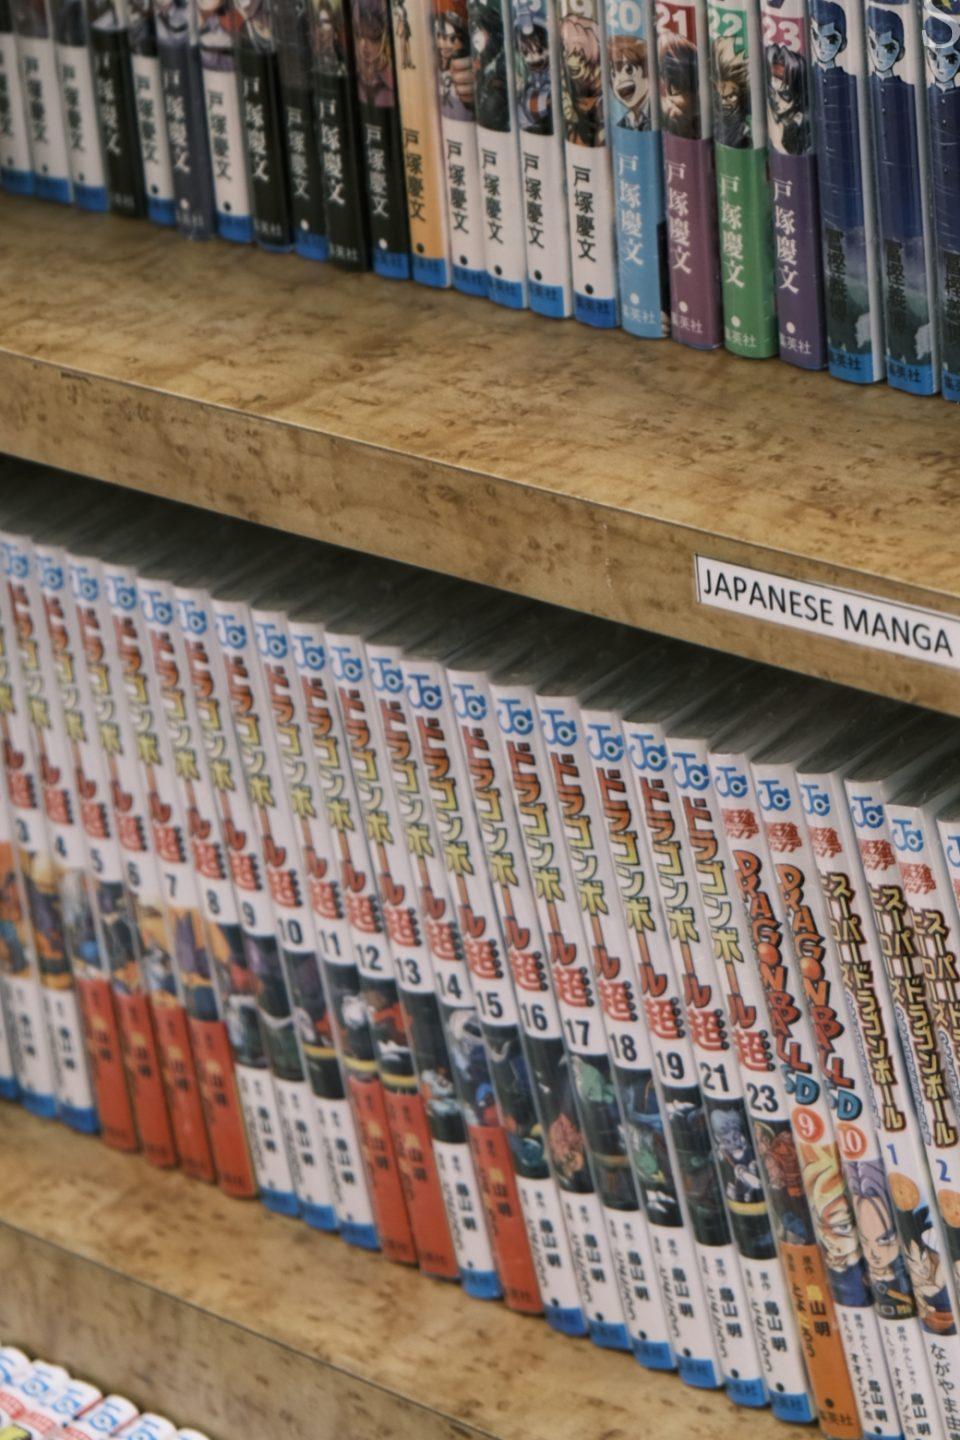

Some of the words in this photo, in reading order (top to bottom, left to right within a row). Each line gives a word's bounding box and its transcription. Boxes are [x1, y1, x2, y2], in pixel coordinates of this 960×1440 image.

[656, 6, 688, 37] 21
[763, 19, 800, 53] 23
[703, 568, 834, 626] JAPANESE
[843, 604, 954, 657] MANGA
[242, 900, 257, 927] 9
[277, 915, 303, 945] 10
[475, 990, 504, 1018] 15
[565, 1019, 590, 1047] 17
[655, 1051, 685, 1080] 19
[702, 1063, 730, 1092] 21
[746, 1082, 779, 1113] 23
[798, 1113, 815, 1137] 9
[840, 1129, 862, 1151] 10
[935, 1158, 952, 1183] 2
